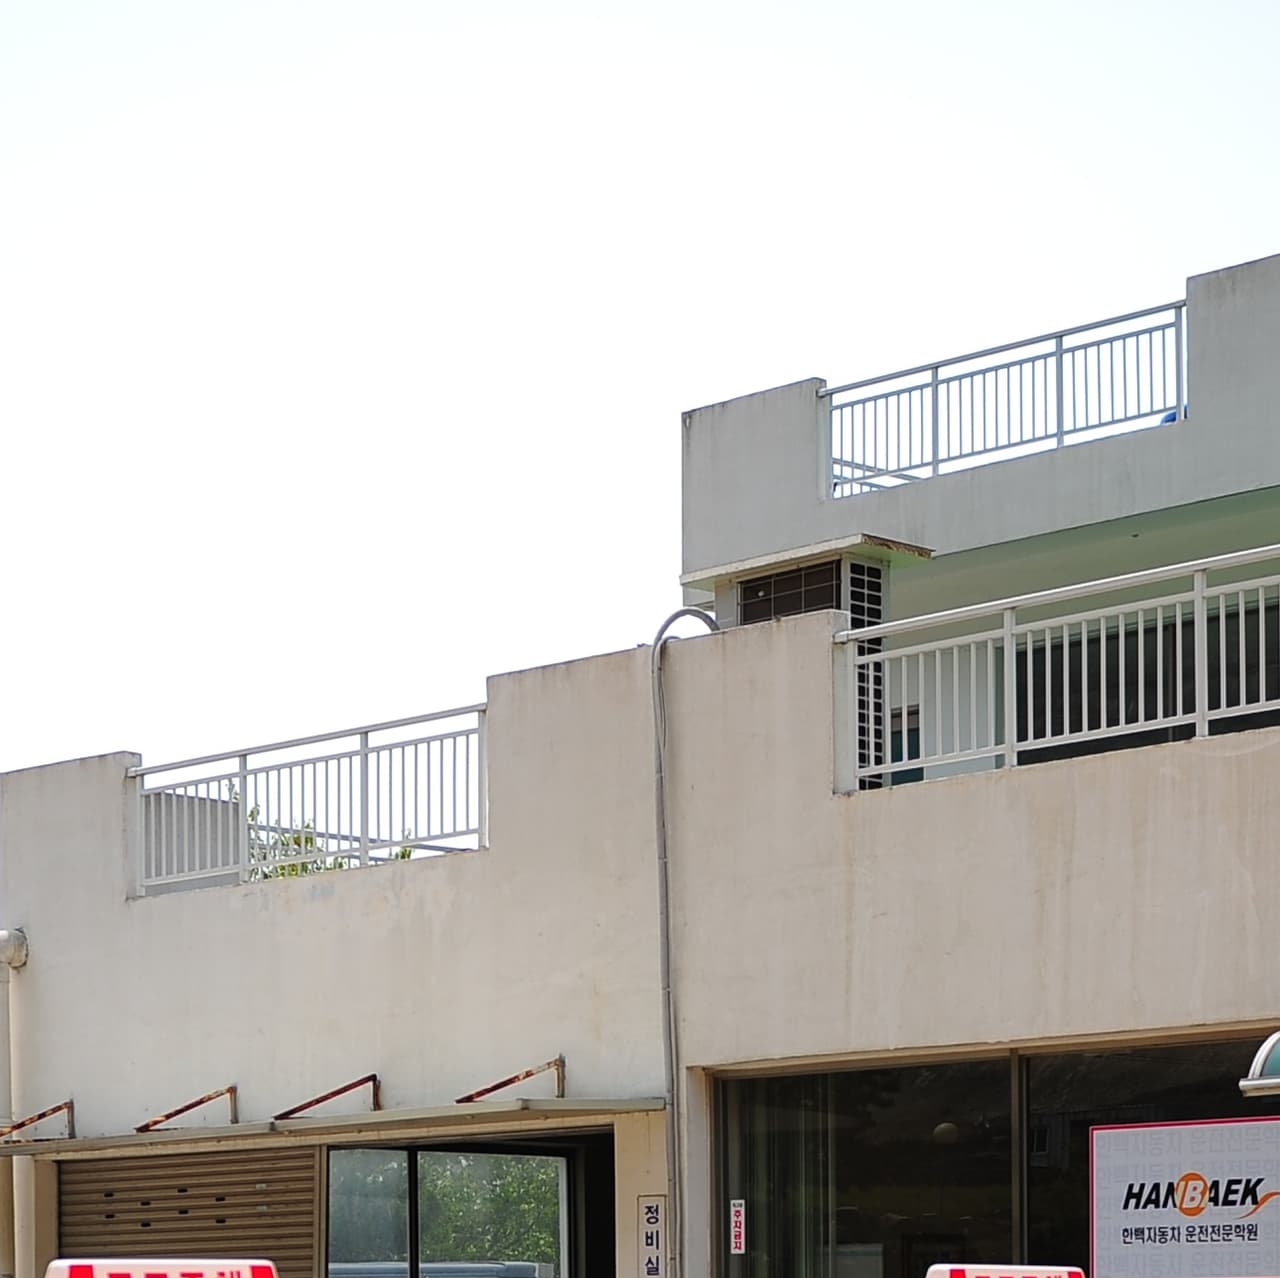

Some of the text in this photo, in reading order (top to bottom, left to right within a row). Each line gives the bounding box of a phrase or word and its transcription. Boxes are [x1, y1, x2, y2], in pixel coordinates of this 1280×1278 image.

[1122, 1176, 1265, 1210] HANBAEK
[644, 1203, 660, 1276] 정비실
[1121, 1226, 1181, 1245] 한백자동차
[1185, 1223, 1259, 1244] 운전전문학원
